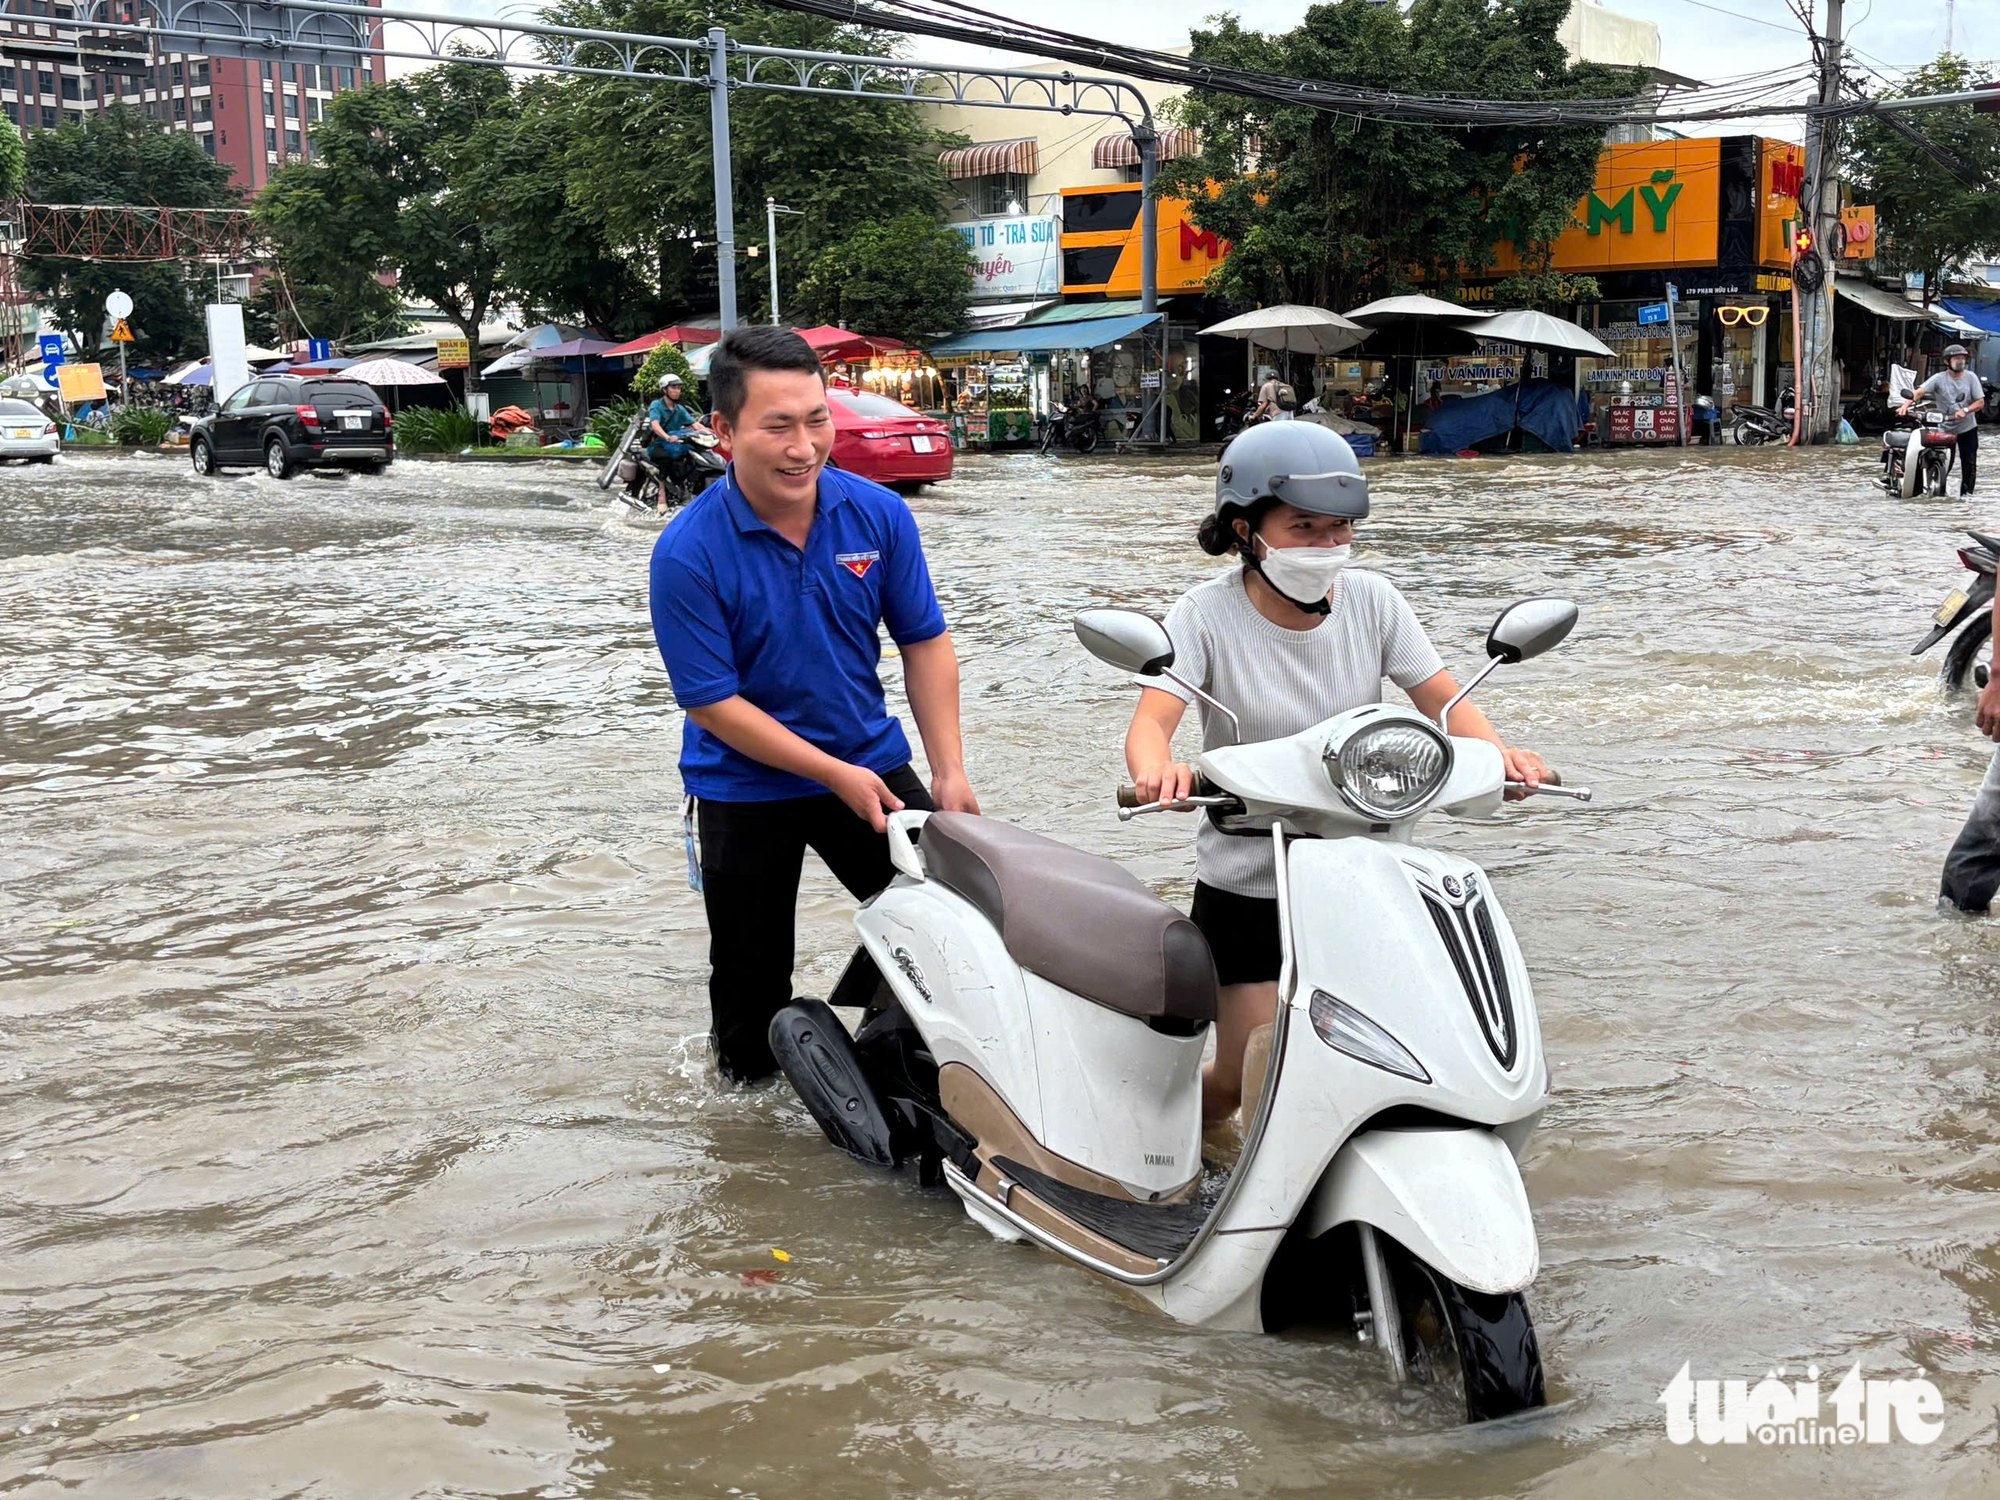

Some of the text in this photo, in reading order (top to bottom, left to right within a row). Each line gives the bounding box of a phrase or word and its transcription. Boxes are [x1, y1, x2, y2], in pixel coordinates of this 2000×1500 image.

[1587, 169, 1684, 235] MỸ
[979, 221, 995, 247] TỐ
[1031, 219, 1054, 243] SỮA
[1427, 366, 1446, 380] TƯ
[1448, 362, 1476, 379] VẤN
[1144, 1154, 1174, 1166] YAMAHA
